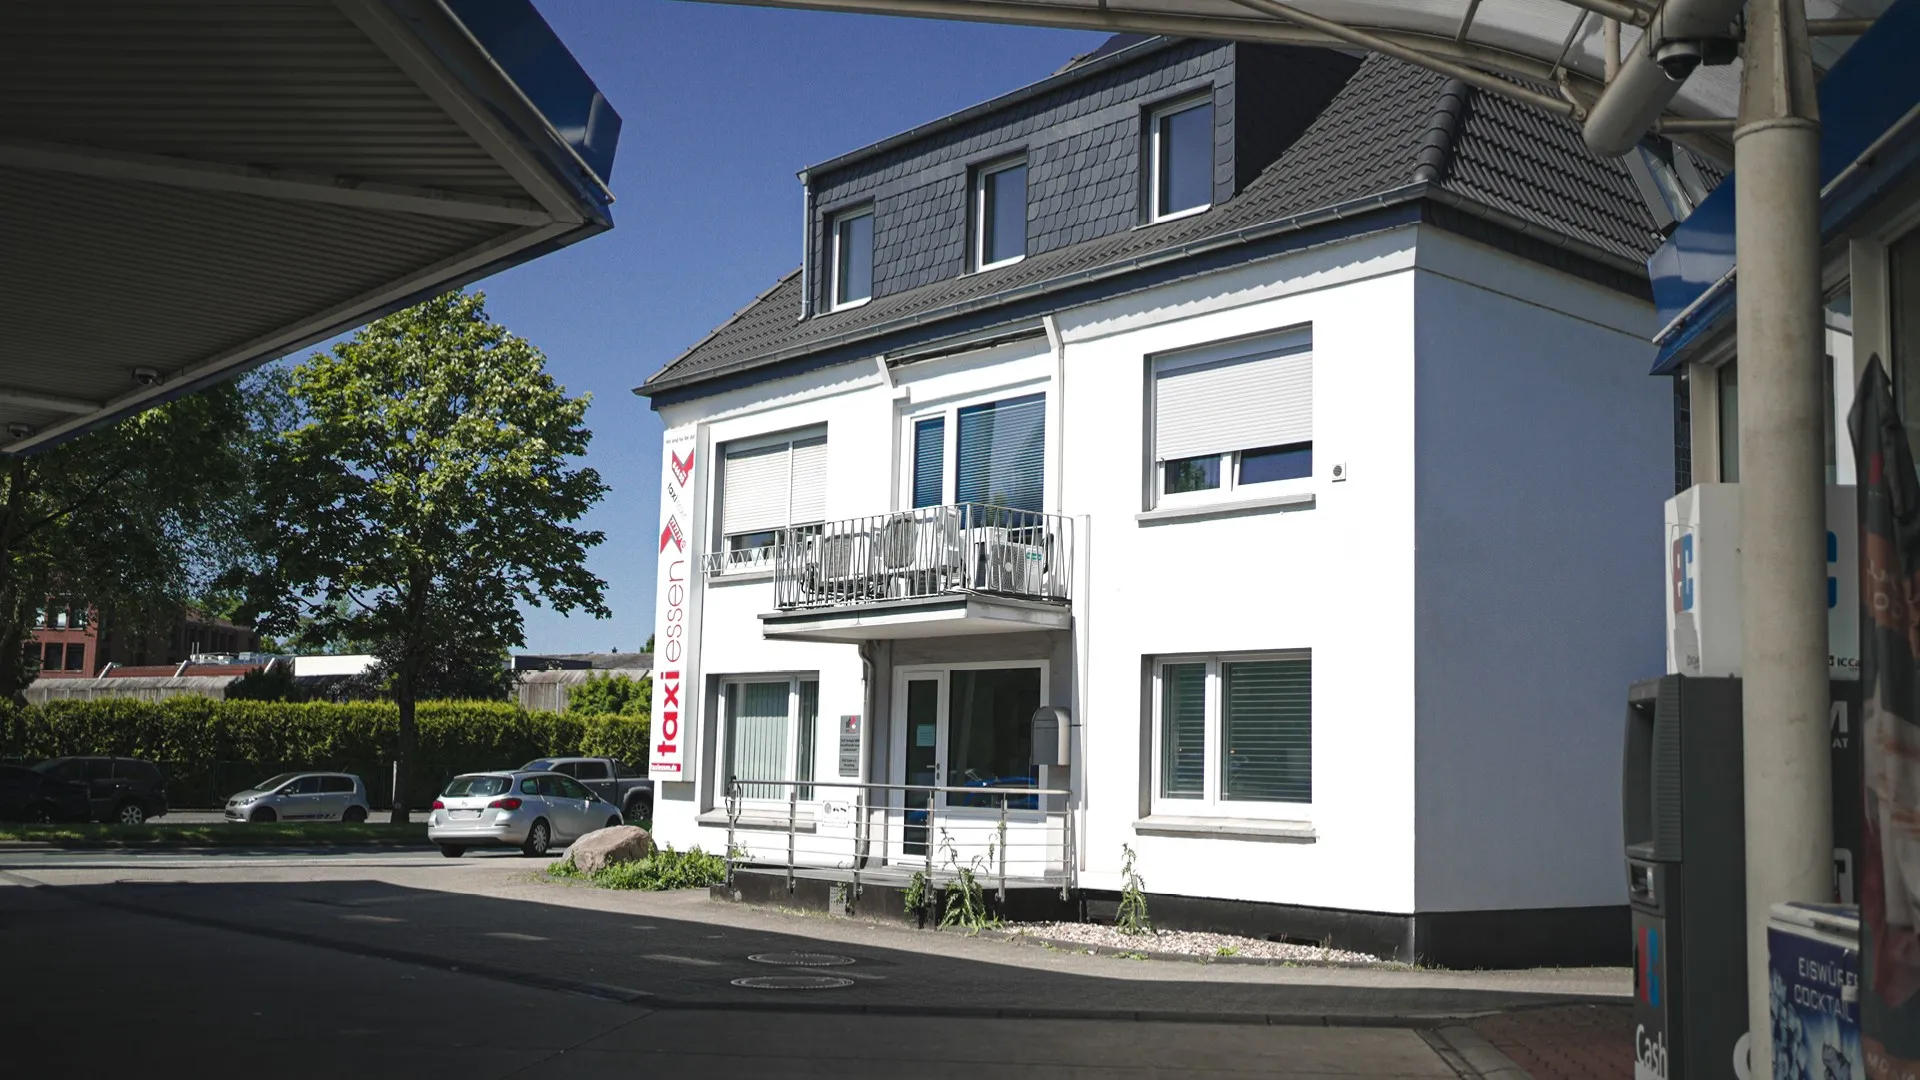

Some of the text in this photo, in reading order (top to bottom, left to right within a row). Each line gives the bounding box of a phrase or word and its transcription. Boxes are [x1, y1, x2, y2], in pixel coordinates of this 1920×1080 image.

[665, 560, 684, 662] essen
[657, 671, 680, 756] taxi
[1794, 984, 1854, 1024] COCKTAIL
[1636, 1023, 1667, 1079] Cash
